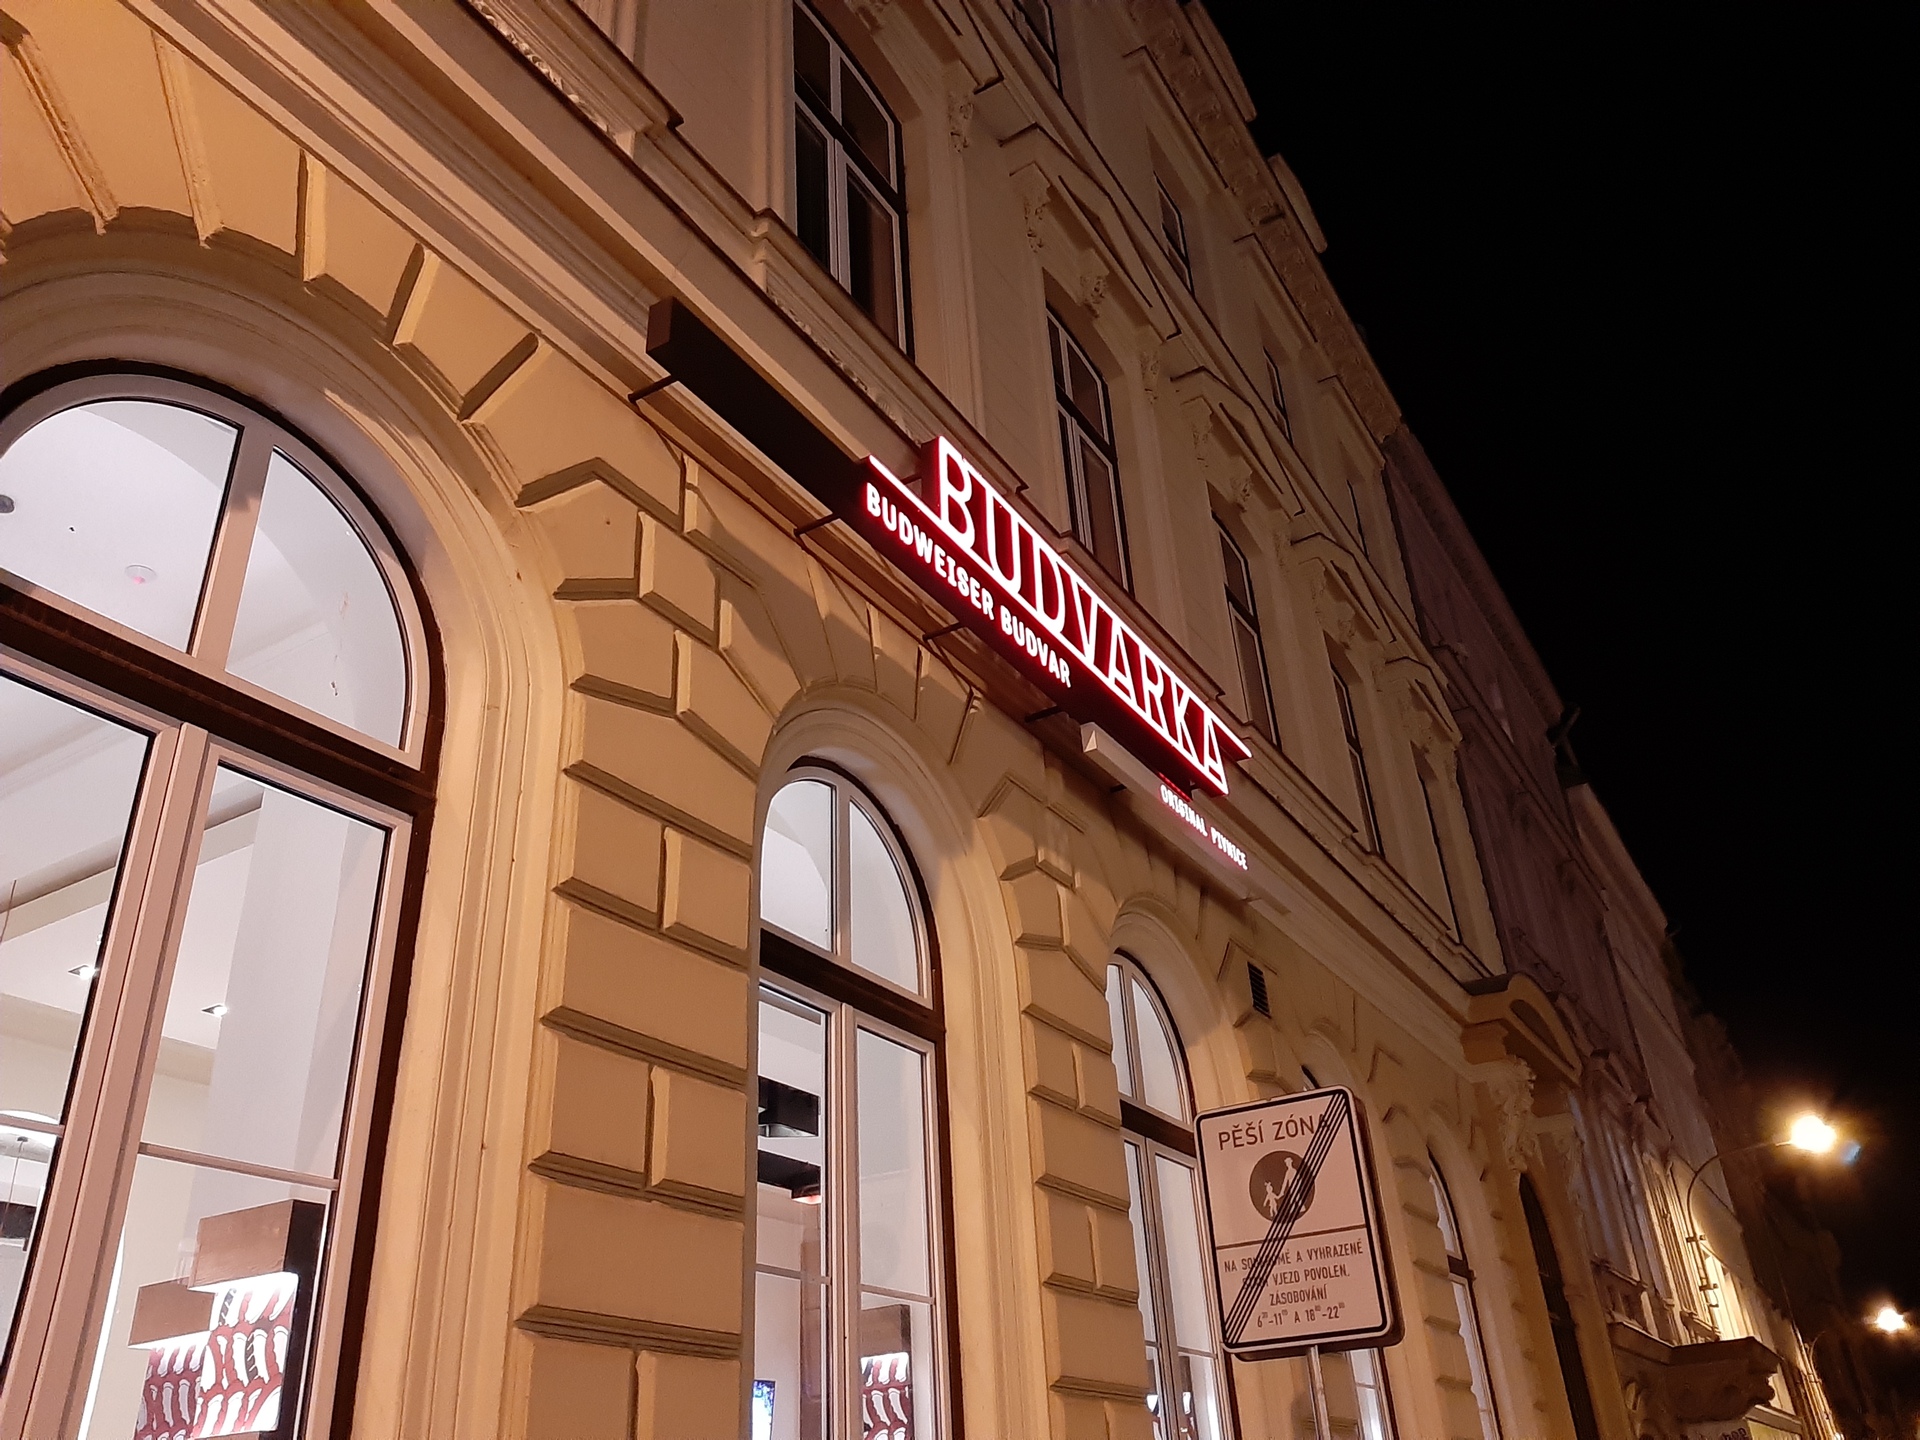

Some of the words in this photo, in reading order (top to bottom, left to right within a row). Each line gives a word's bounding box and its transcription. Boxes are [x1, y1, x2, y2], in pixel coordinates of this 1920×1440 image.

[866, 482, 995, 621] BUDWEISER
[1000, 604, 1072, 688] BUDVAR
[937, 435, 1230, 795] BUDVARKA
[1159, 784, 1208, 837] ORIGINAL
[1218, 1119, 1264, 1151] PĚŠÍ
[1224, 1260, 1238, 1273] NA
[1296, 1250, 1304, 1263] A
[1307, 1238, 1364, 1261] VYHRAZENÉ
[1304, 1263, 1351, 1281] POVOLEN.
[1269, 1283, 1328, 1307] ZÁSOBOVÁNÍ
[1294, 1310, 1301, 1324] A
